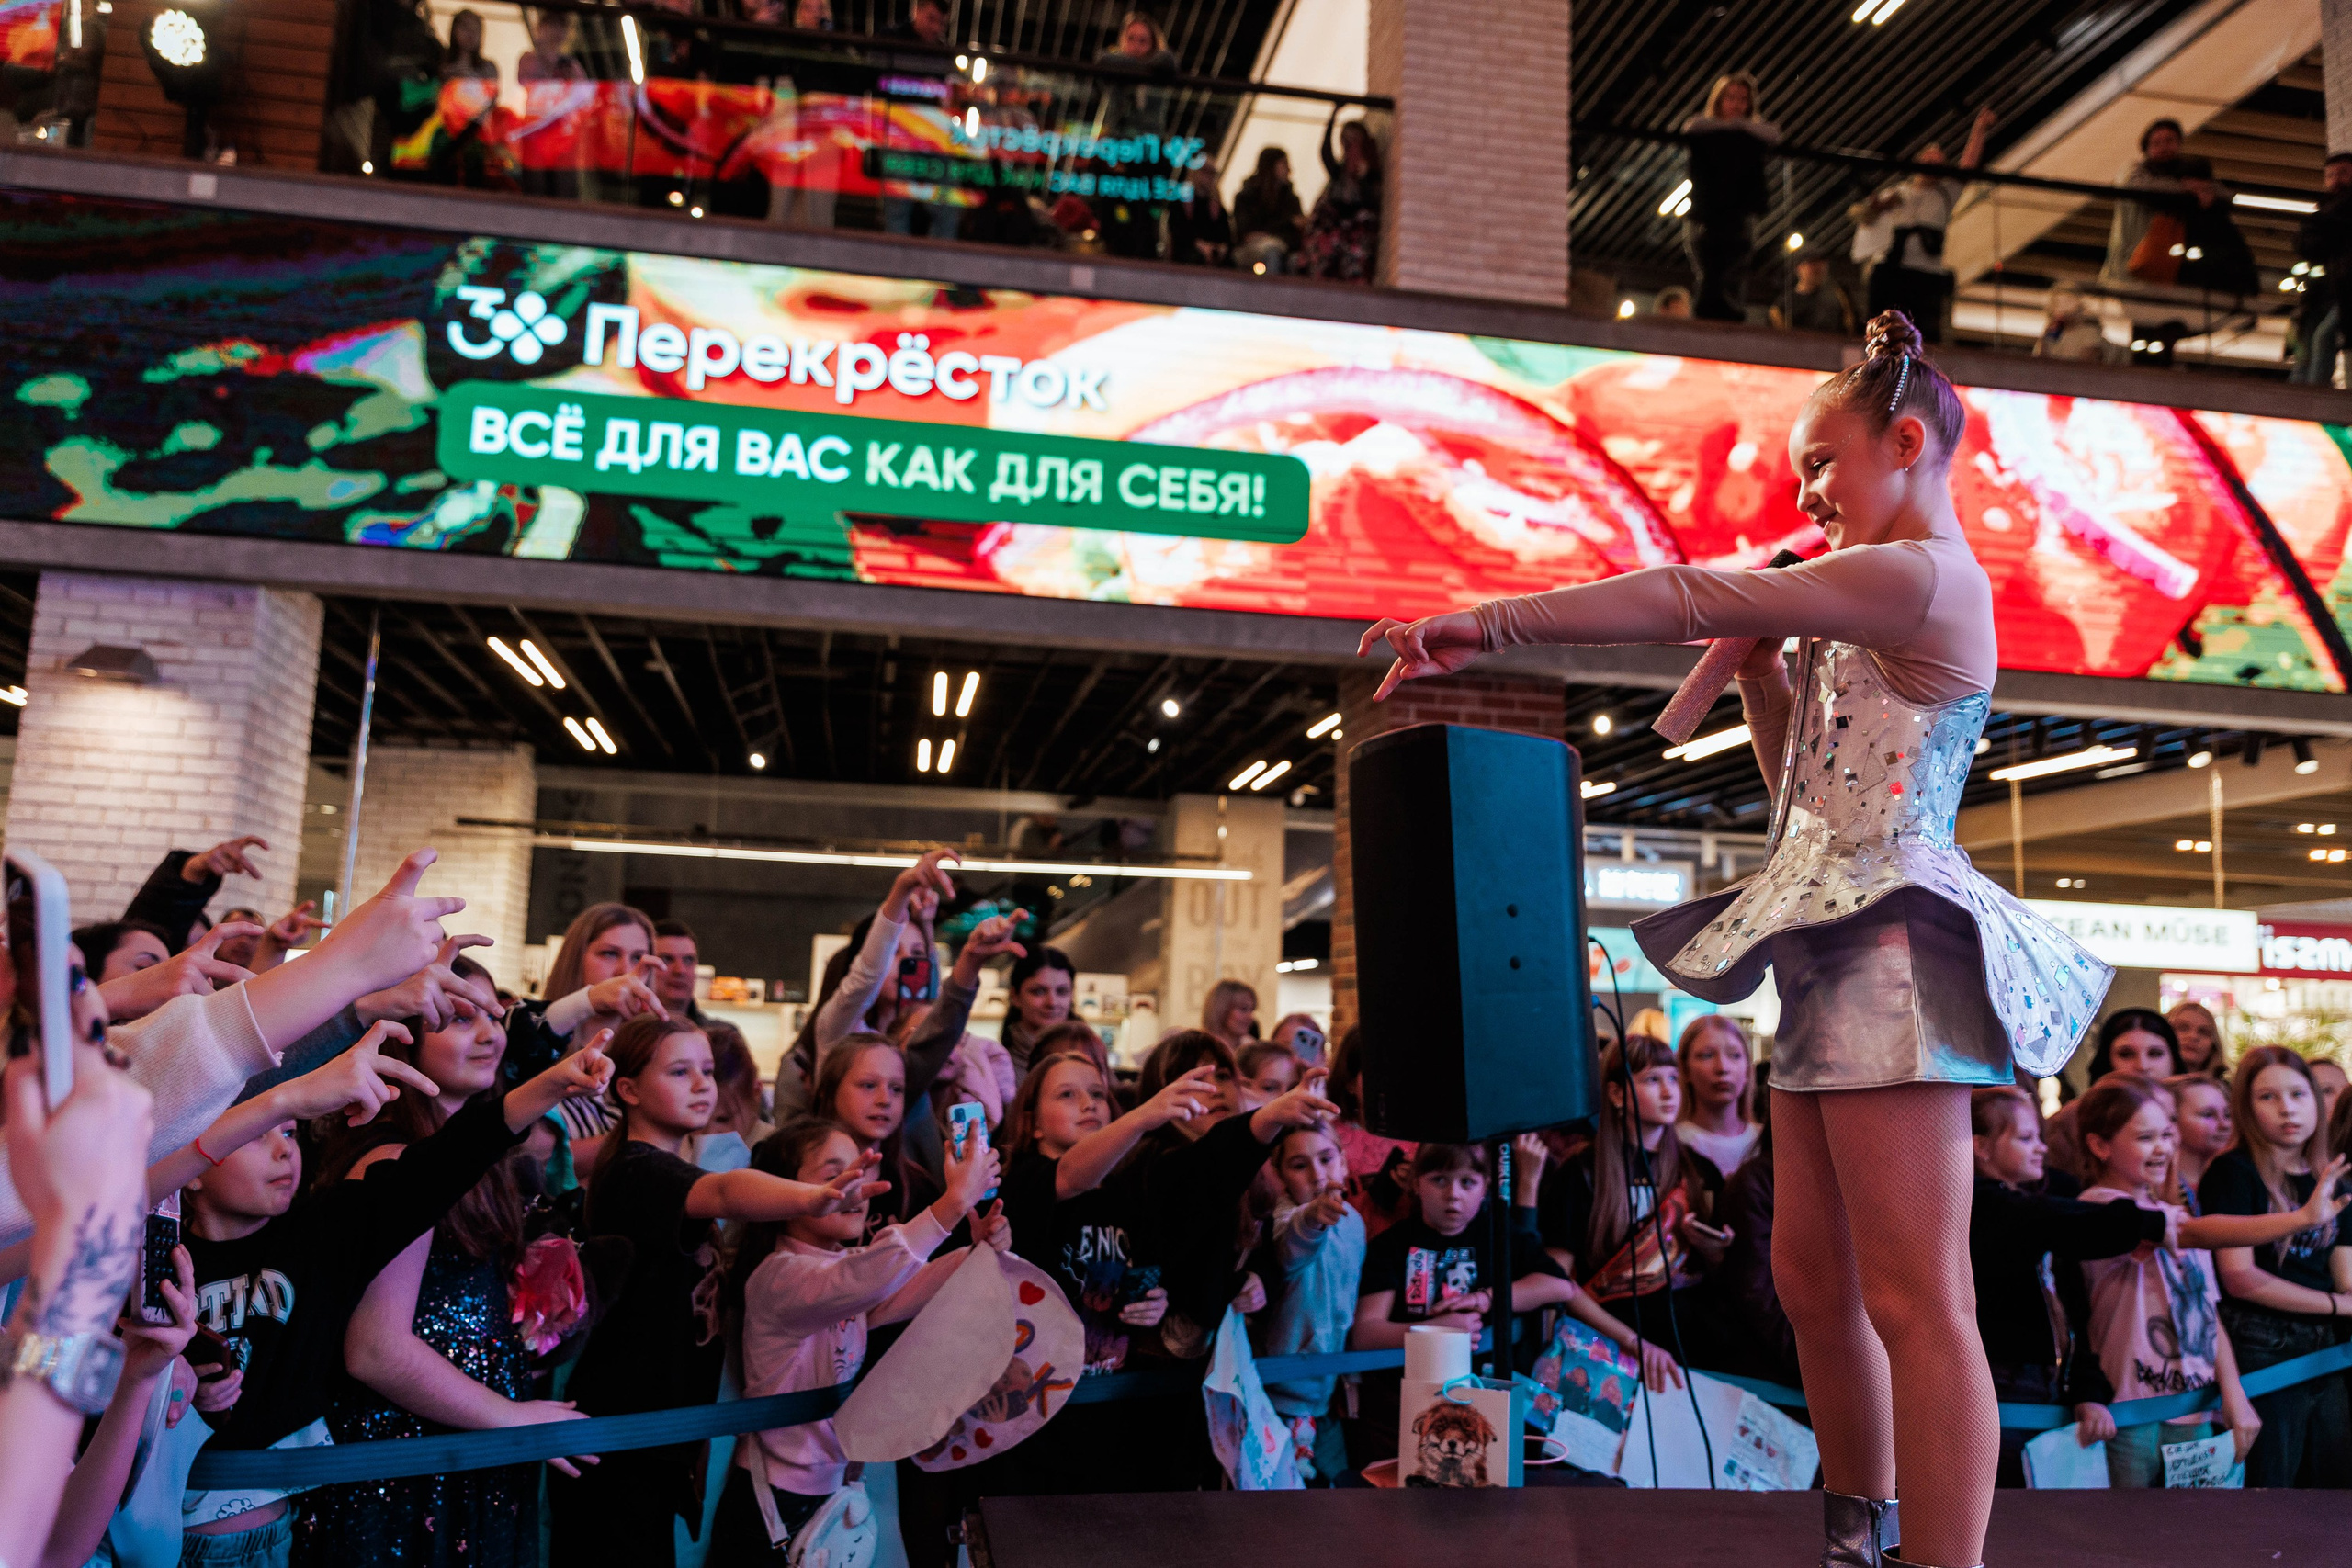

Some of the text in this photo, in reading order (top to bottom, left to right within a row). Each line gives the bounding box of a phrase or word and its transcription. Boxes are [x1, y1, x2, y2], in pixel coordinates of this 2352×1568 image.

[583, 302, 1107, 411] Перекрёсток
[469, 402, 1268, 518] ВСЁ ДЛЯ ВАС КАК ДЛЯ СЕБЯ!
